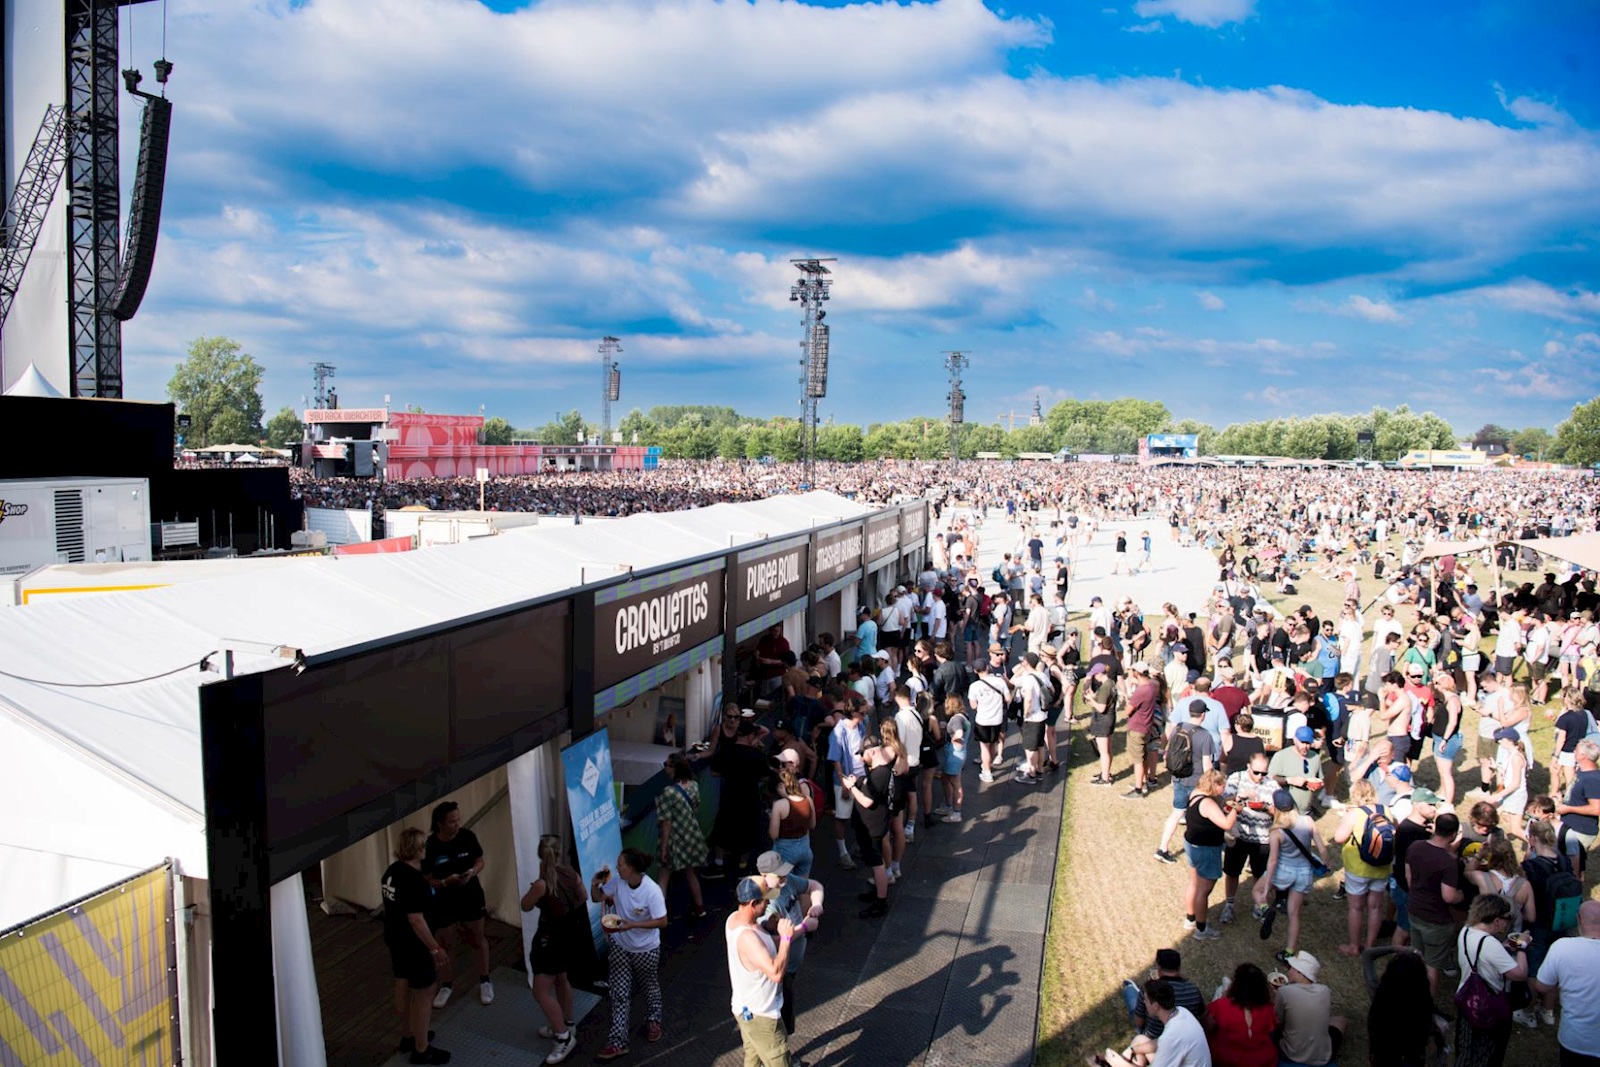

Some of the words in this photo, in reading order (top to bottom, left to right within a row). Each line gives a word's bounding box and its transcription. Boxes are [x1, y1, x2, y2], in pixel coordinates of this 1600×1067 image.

[309, 411, 323, 421] YOU
[324, 411, 342, 421] ROCK
[344, 410, 383, 420] WERCHTER
[778, 552, 800, 588] BOWL
